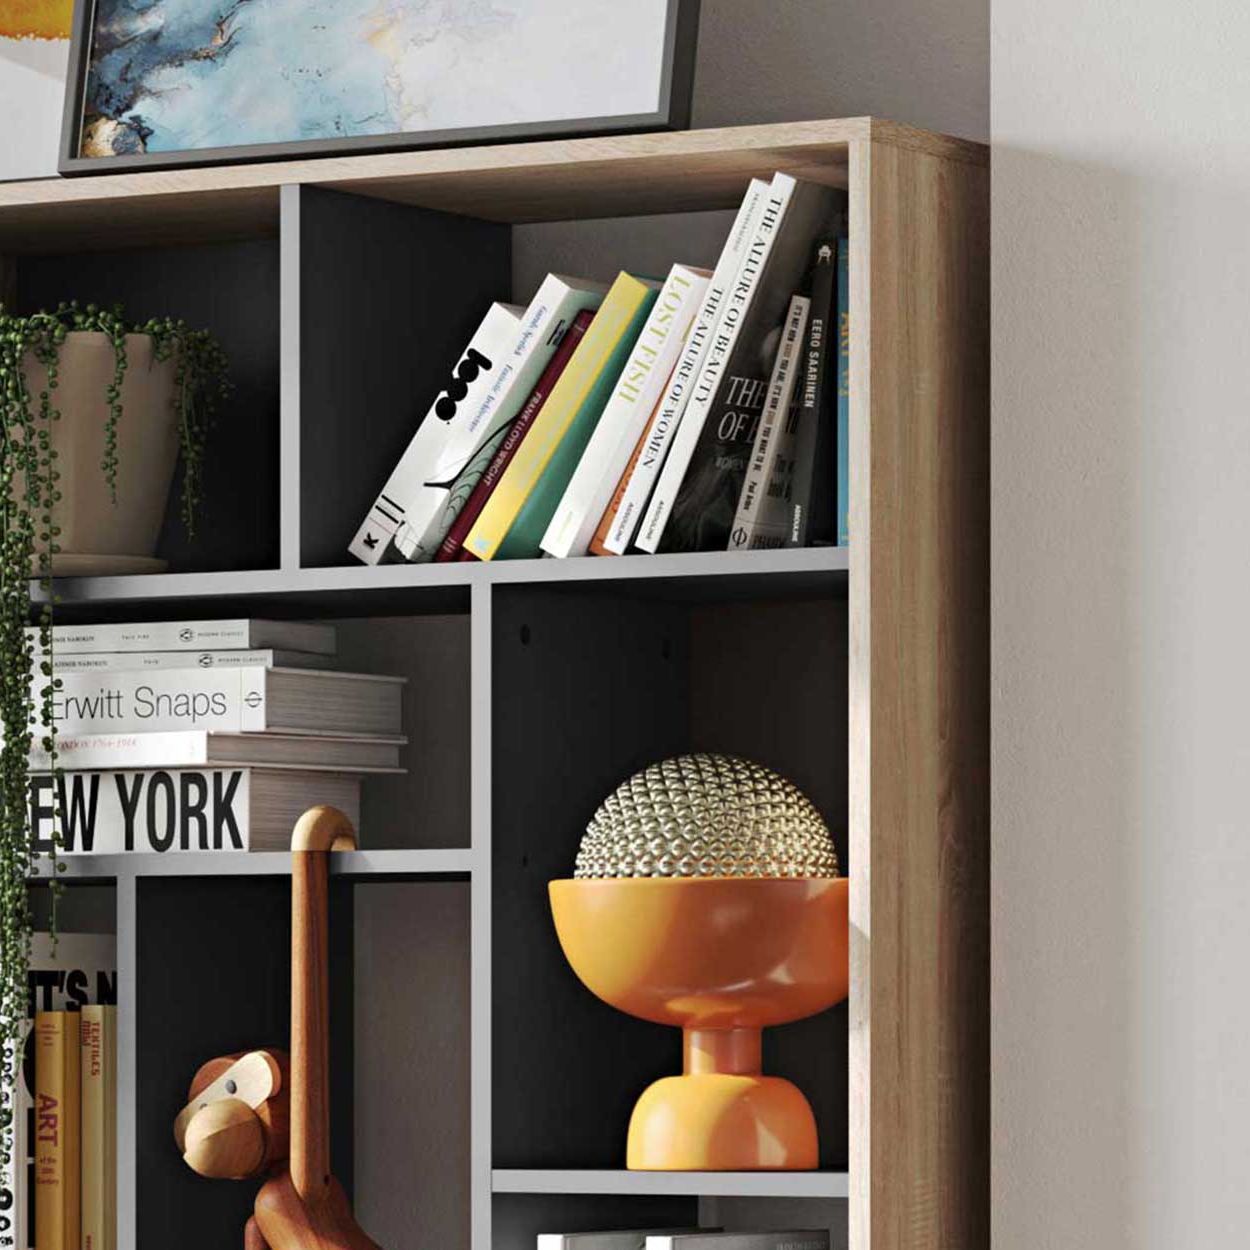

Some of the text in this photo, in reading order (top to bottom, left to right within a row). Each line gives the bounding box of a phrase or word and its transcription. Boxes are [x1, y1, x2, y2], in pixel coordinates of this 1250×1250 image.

[758, 197, 785, 235] THE
[732, 235, 766, 307] ALLURE
[618, 275, 692, 404] LOST FISH
[722, 307, 741, 335] OF
[642, 287, 723, 469] THE ALLURE OF WOMEN
[695, 333, 730, 403] BEAUTY
[727, 376, 768, 409] THE
[804, 319, 823, 408] EERO SAARINEN
[484, 391, 542, 487] FRANK LLOYD WRIGHT
[363, 532, 379, 550] K
[51, 687, 125, 720] Erwitt
[134, 686, 227, 723] Snaps
[14, 771, 244, 853] EW YORK
[38, 1092, 59, 1147] ART
